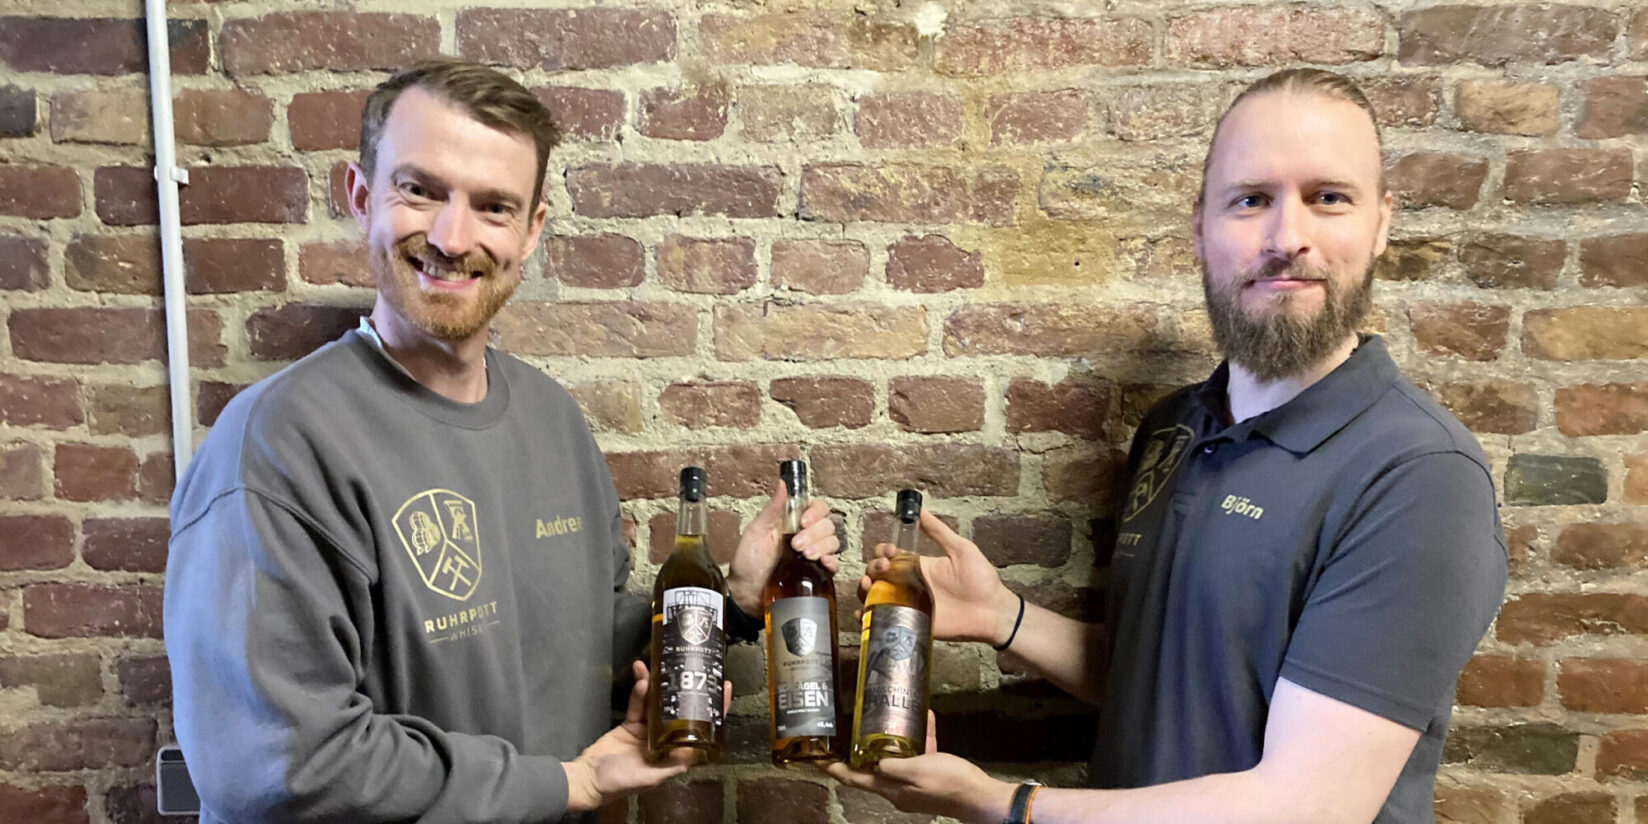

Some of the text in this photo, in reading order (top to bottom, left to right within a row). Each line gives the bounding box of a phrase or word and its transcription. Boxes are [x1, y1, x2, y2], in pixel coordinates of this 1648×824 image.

[1221, 494, 1264, 520] Björn
[424, 601, 497, 634] RUHRPOTT
[778, 690, 829, 710] EISEN
